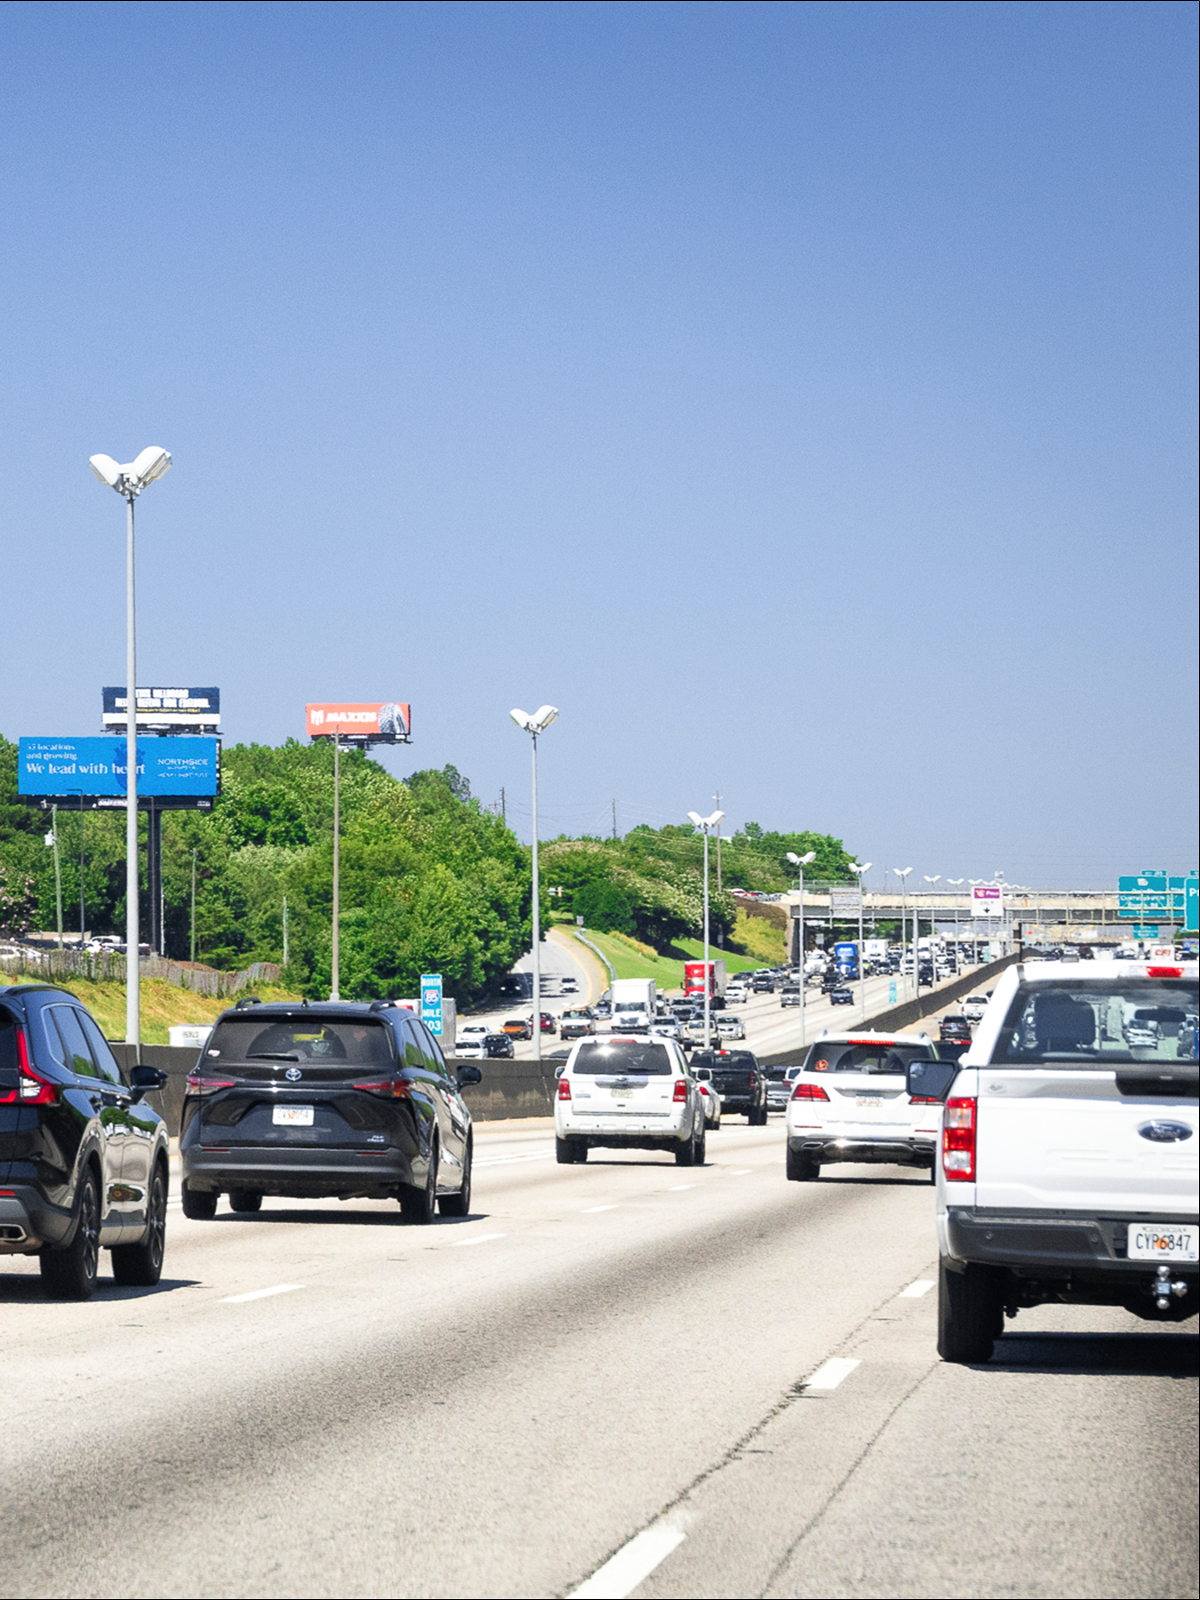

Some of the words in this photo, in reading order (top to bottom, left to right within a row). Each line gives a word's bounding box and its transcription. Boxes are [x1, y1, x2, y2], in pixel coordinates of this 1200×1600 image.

[325, 712, 378, 723] MAXXIS
[37, 743, 76, 751] locations
[26, 752, 42, 760] and
[157, 758, 209, 766] NORTHSIDE
[26, 763, 45, 774] We
[48, 763, 76, 774] lead
[79, 763, 108, 774] with
[112, 763, 146, 775] hert
[426, 992, 439, 1002] 85
[422, 1008, 441, 1018] MILE
[1136, 1233, 1191, 1250] CYP6847
